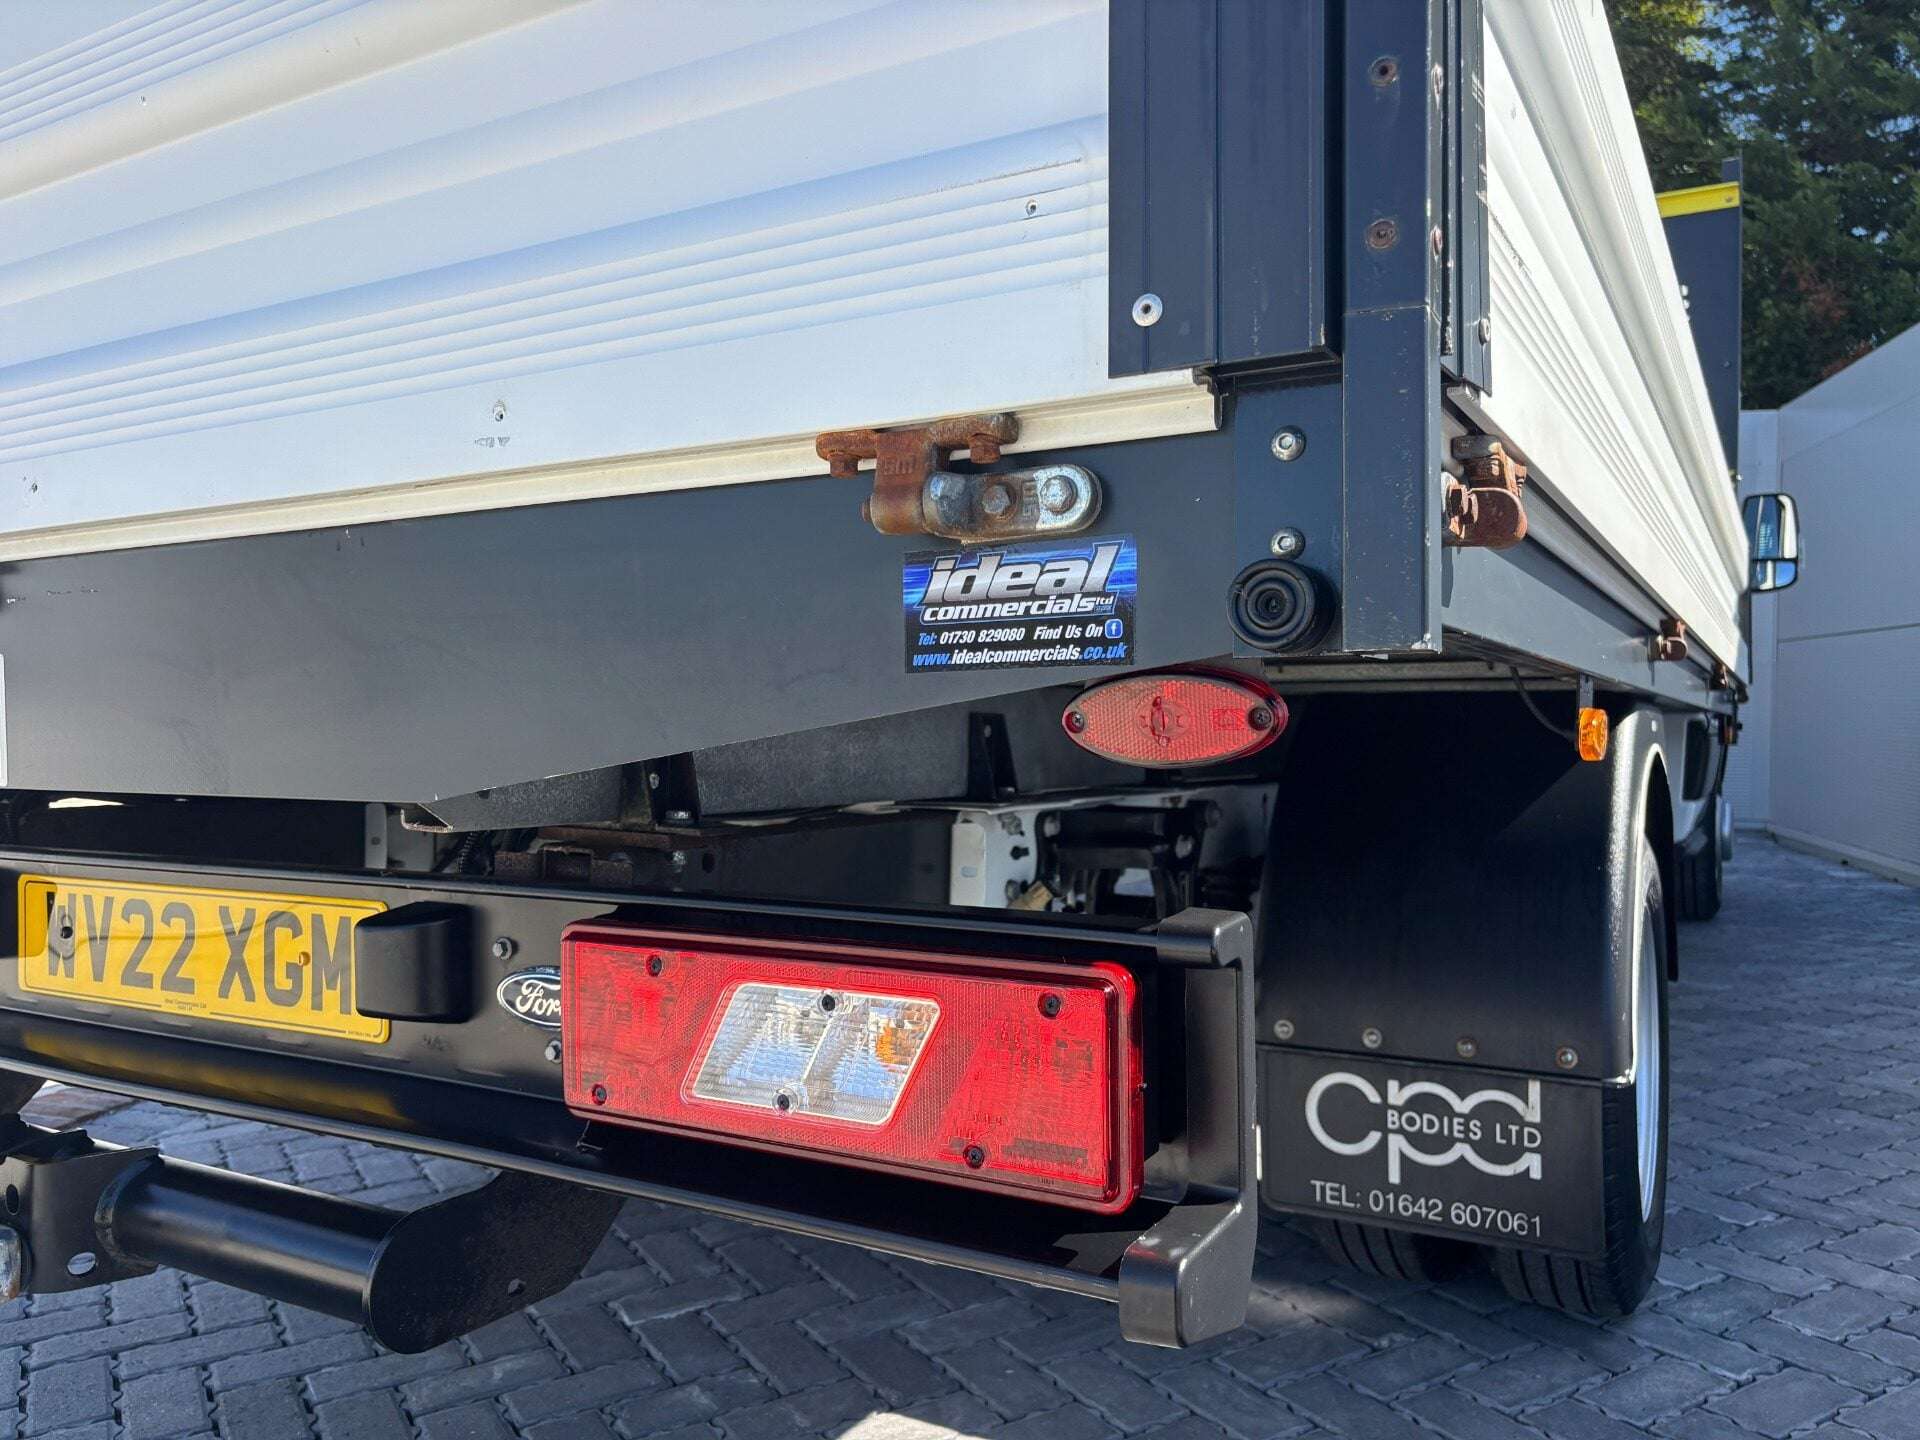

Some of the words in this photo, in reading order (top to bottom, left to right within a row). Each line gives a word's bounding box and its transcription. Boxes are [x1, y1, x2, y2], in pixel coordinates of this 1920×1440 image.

[922, 543, 1121, 604] ideal
[923, 593, 1096, 623] commercials
[918, 631, 937, 646] Tel:
[939, 629, 975, 645] 01730
[977, 627, 1026, 643] 829080
[1033, 624, 1063, 641] Find
[1065, 624, 1083, 639] Us
[1085, 623, 1104, 638] On
[912, 643, 1128, 666] www.idealcommercials.co.uk
[217, 905, 353, 1016] XGM
[515, 979, 562, 1017] For
[1386, 1109, 1483, 1141] BODIES
[1495, 1123, 1542, 1149] LTD
[1310, 1179, 1362, 1209] TEL:
[1368, 1189, 1443, 1222] 01642
[1450, 1204, 1542, 1238] 607061
